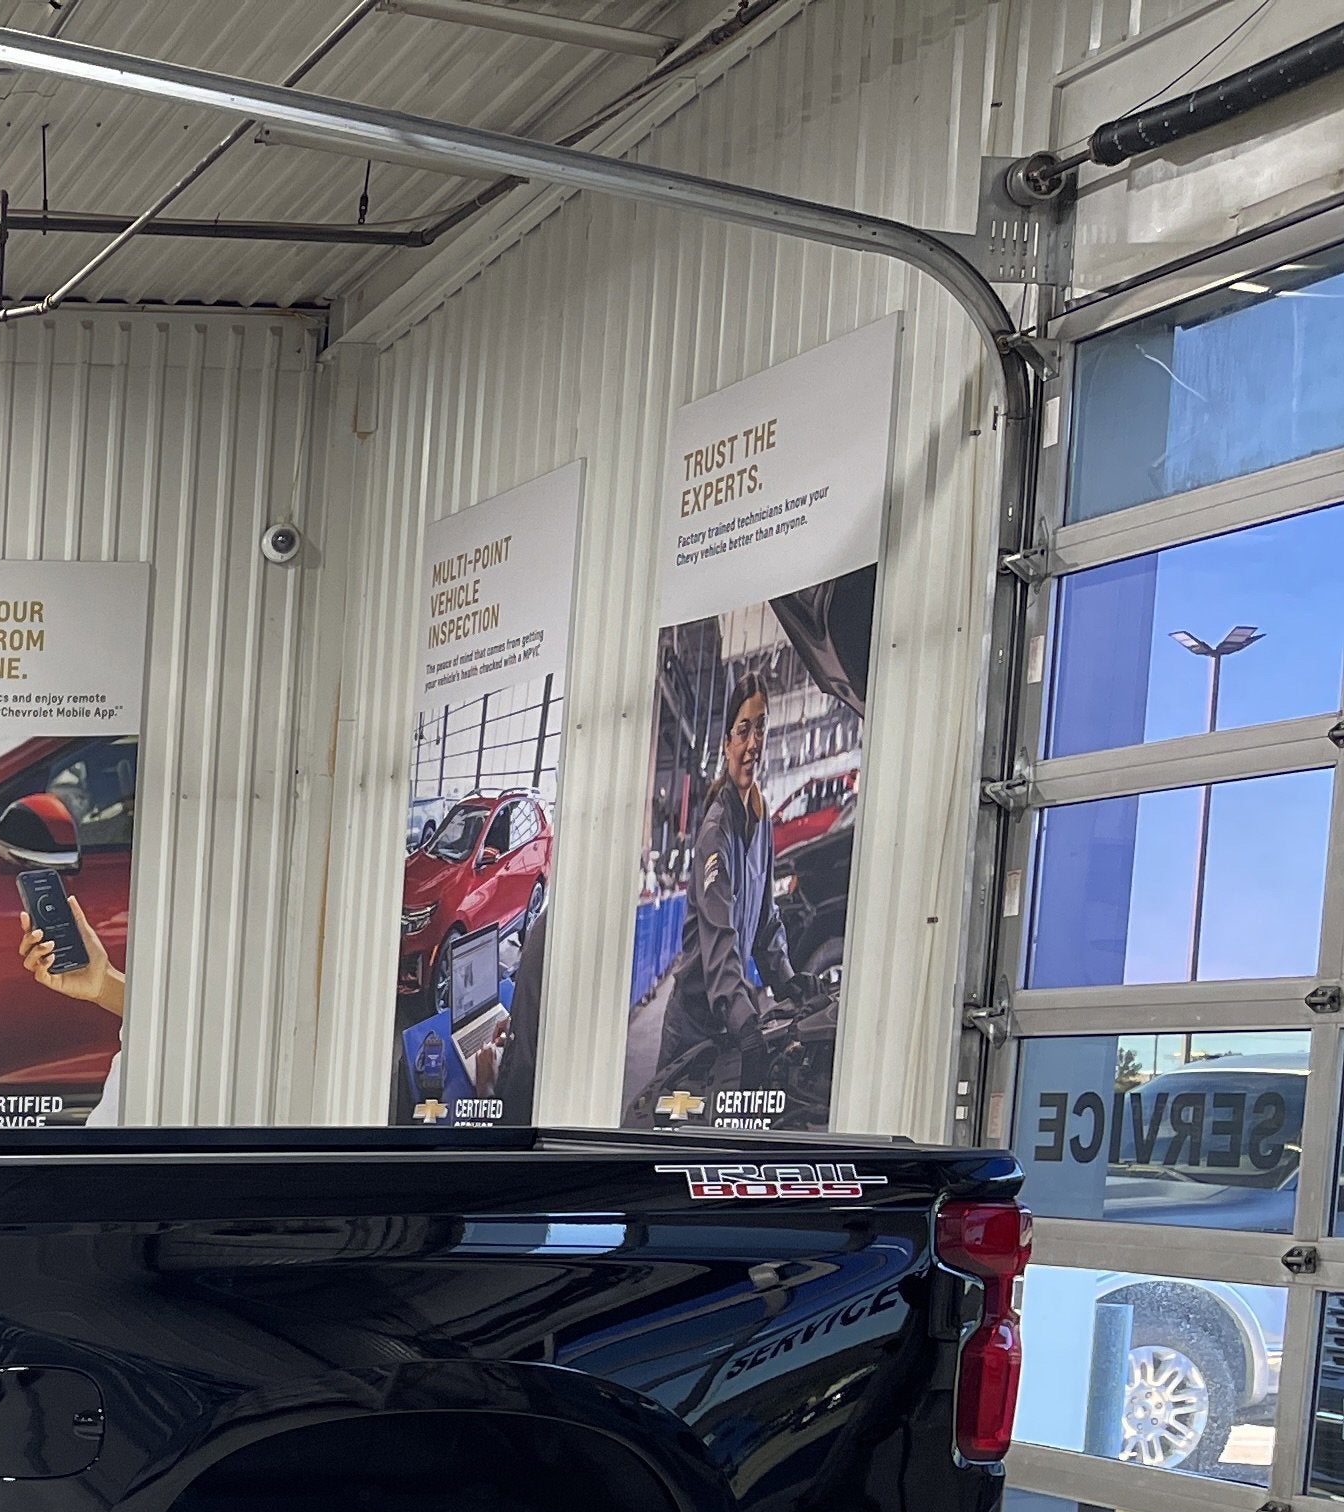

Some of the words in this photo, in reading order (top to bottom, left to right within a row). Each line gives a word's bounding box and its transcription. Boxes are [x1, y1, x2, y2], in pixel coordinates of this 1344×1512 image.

[683, 434, 739, 481] TRUST
[743, 418, 777, 458] THE
[680, 464, 763, 518] EXPERTS.
[678, 530, 706, 549] Factory
[707, 517, 736, 540] trained
[737, 502, 783, 529] technicians
[784, 494, 807, 513] know
[809, 486, 830, 507] your
[676, 551, 699, 567] Chevy
[700, 540, 727, 560] vehicle
[728, 531, 753, 551] better
[755, 525, 774, 541] than
[775, 513, 808, 535] anyone.
[432, 535, 512, 588] MULTI-POINT
[430, 579, 481, 618] VEHICLE
[428, 603, 500, 649] INSPECTION
[426, 662, 435, 675] The
[436, 658, 452, 674] peace
[453, 654, 459, 669] of
[459, 651, 473, 666] mind
[474, 647, 486, 661] that
[487, 643, 506, 657] comes
[506, 637, 521, 650] from
[521, 629, 545, 649] getting
[12, 691, 32, 704] and
[35, 692, 63, 706] enjoy
[67, 693, 107, 704] remote
[56, 706, 91, 718] Mobile
[455, 1099, 504, 1119] CERTIFIED
[716, 1090, 786, 1114] CERTIFIED
[654, 1163, 888, 1184] TRAIL
[689, 1181, 863, 1200] BOSS
